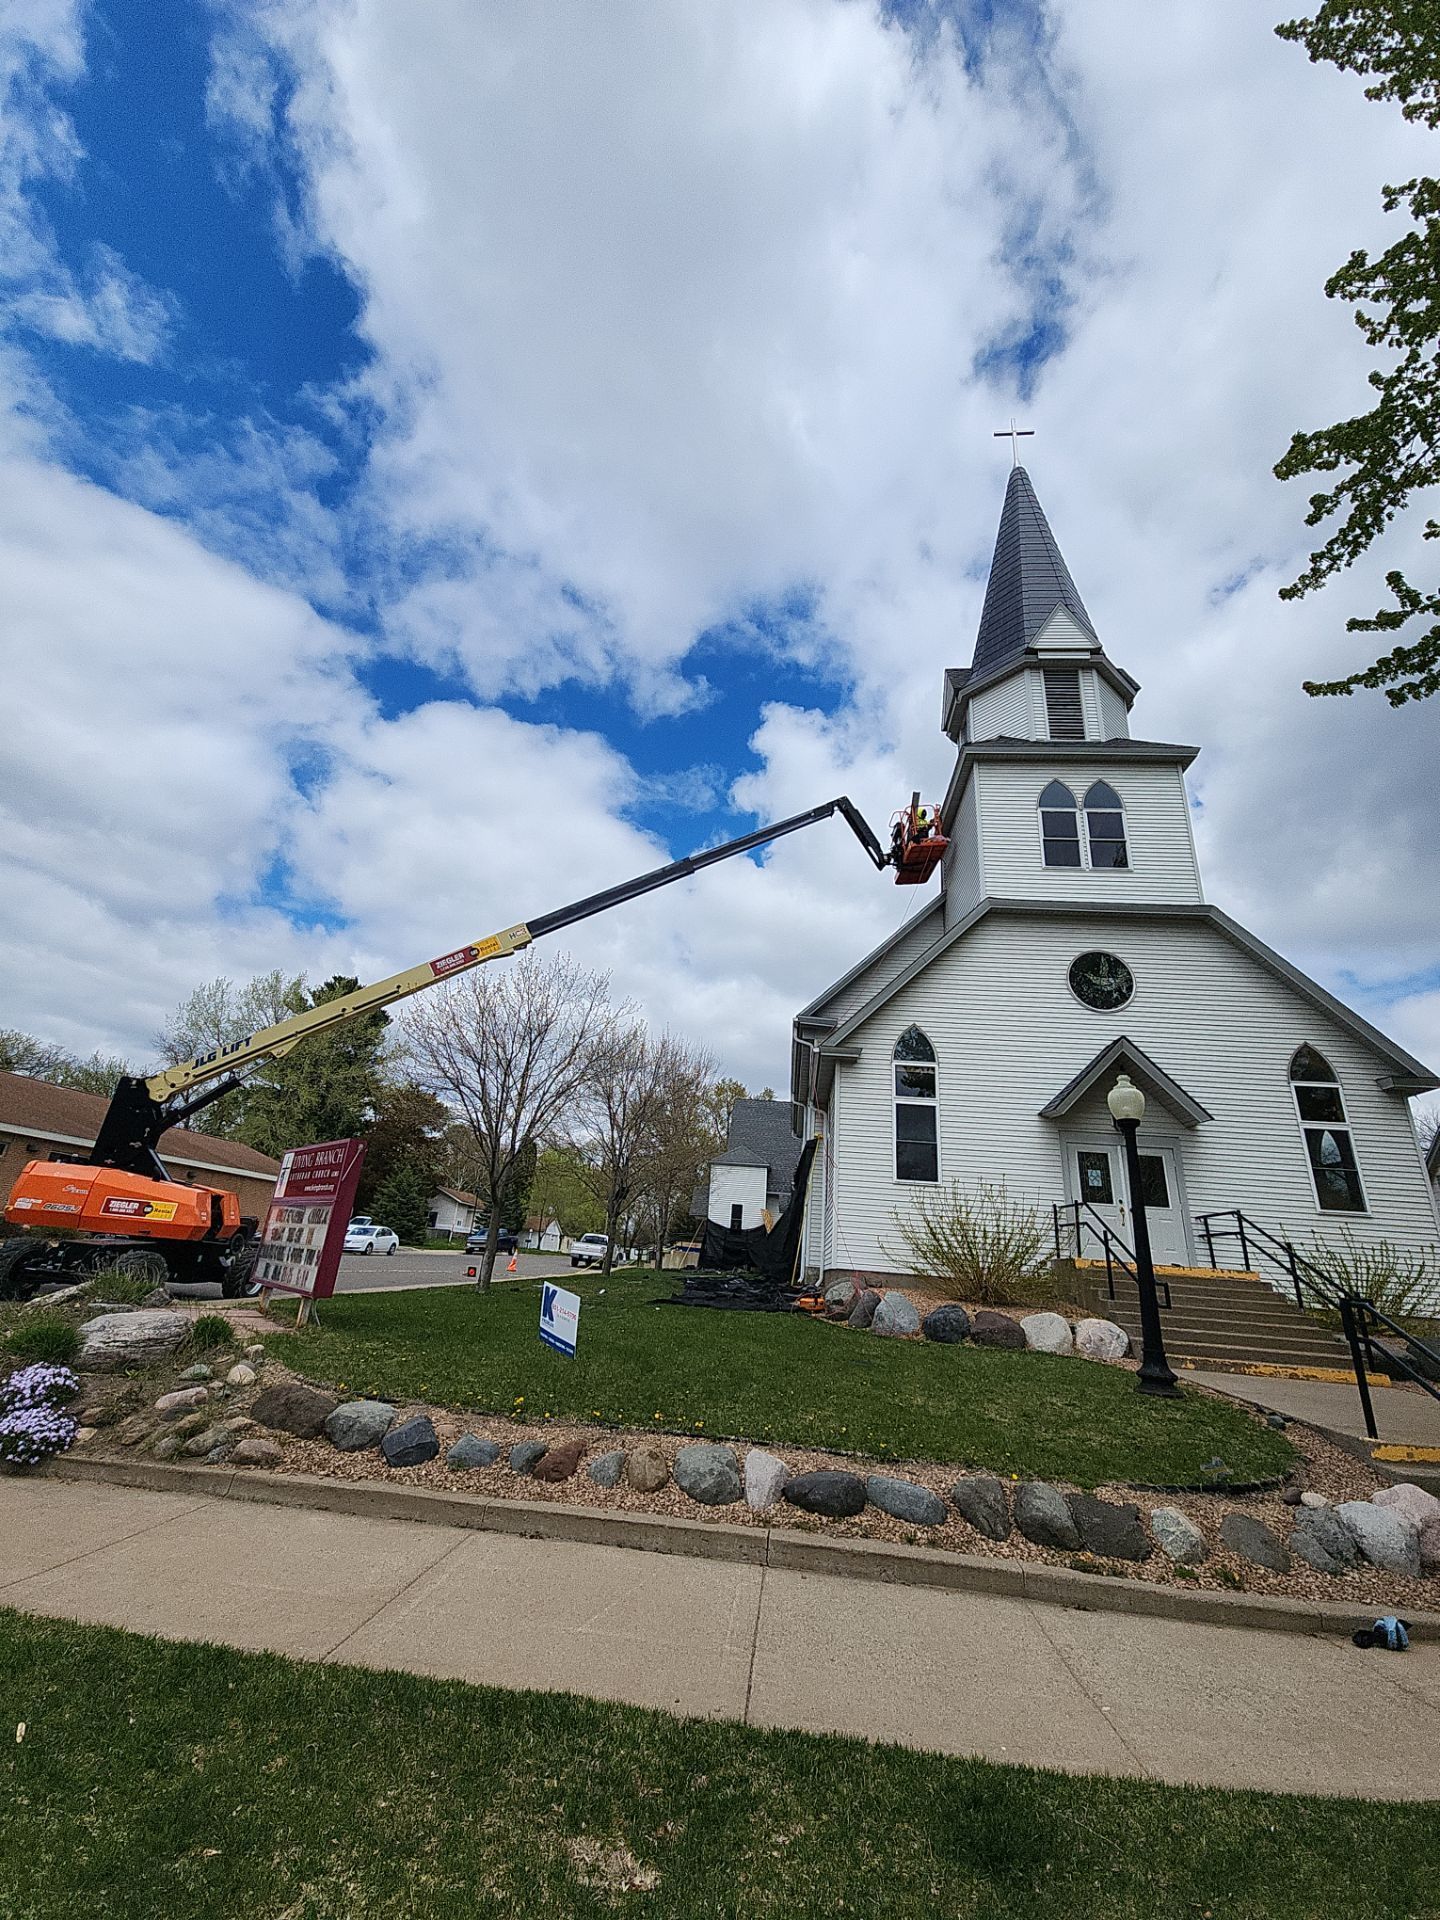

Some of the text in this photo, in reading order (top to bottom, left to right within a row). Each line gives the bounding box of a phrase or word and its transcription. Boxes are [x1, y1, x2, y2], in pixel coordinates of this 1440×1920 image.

[436, 952, 465, 969] ZIEGLER
[192, 1036, 252, 1070] JLG LIFT
[293, 1148, 345, 1169] LIVING BRANCH
[109, 1201, 139, 1209] ZIEGLER
[542, 1286, 557, 1322] K
